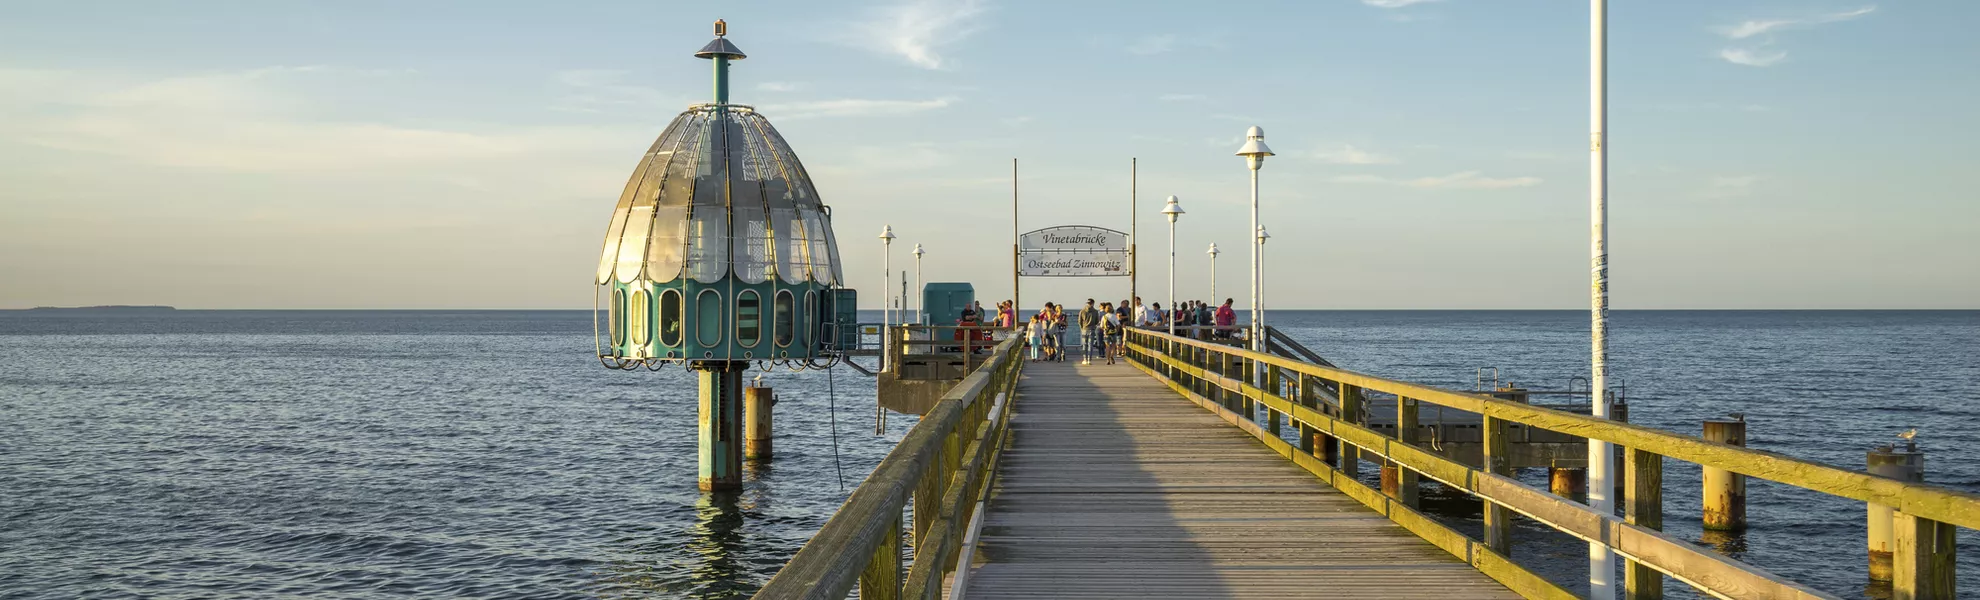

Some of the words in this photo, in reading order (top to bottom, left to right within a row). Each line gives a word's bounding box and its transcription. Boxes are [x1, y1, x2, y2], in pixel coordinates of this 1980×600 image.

[1042, 233, 1106, 246] Vinetabrücke
[1028, 259, 1073, 268] Ostseebad
[1073, 259, 1121, 269] Zinnowitz
